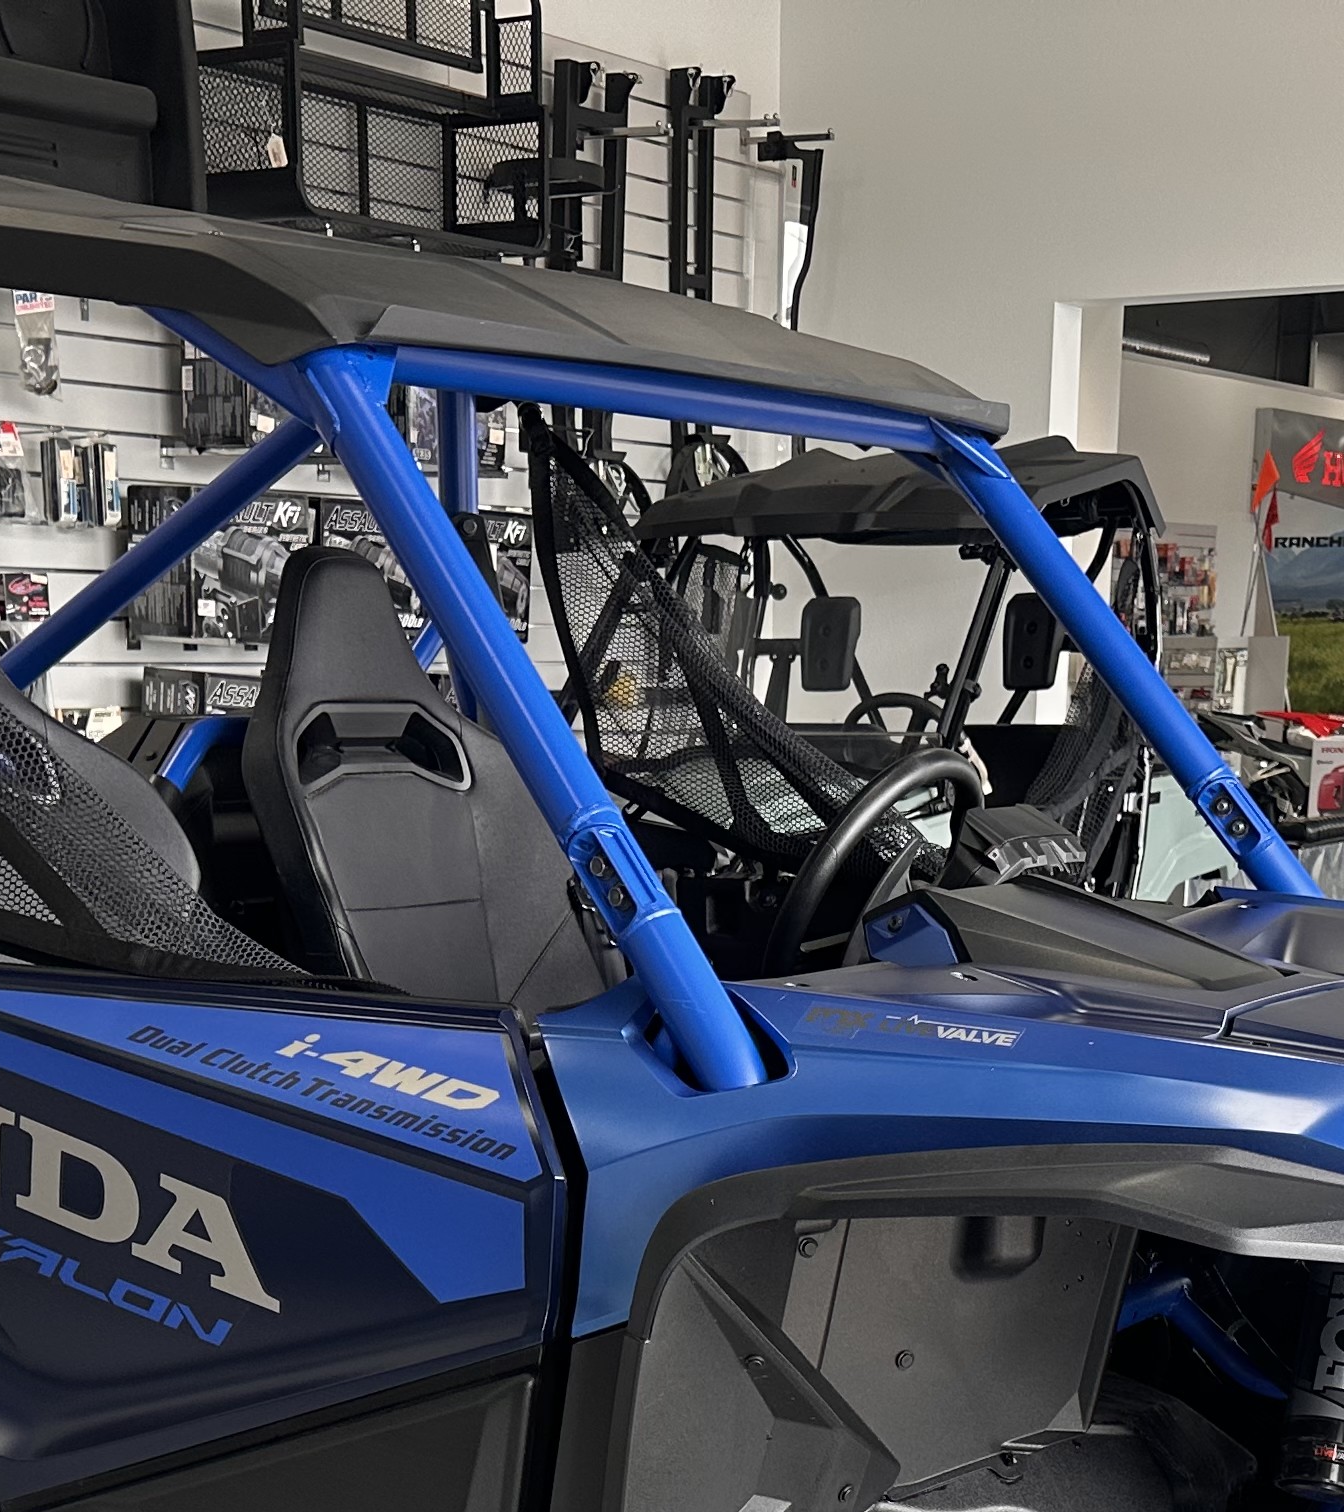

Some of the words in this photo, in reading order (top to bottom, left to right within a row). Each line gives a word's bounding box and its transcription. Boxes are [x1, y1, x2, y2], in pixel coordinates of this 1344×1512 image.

[272, 501, 302, 528] KFi
[503, 520, 527, 545] KFi
[207, 680, 260, 708] ASSA
[937, 1025, 1017, 1047] VALVE
[274, 1033, 501, 1111] i-4WD
[126, 1024, 206, 1059] Dual
[200, 1047, 302, 1091] Clutch
[299, 1076, 518, 1162] Transmission
